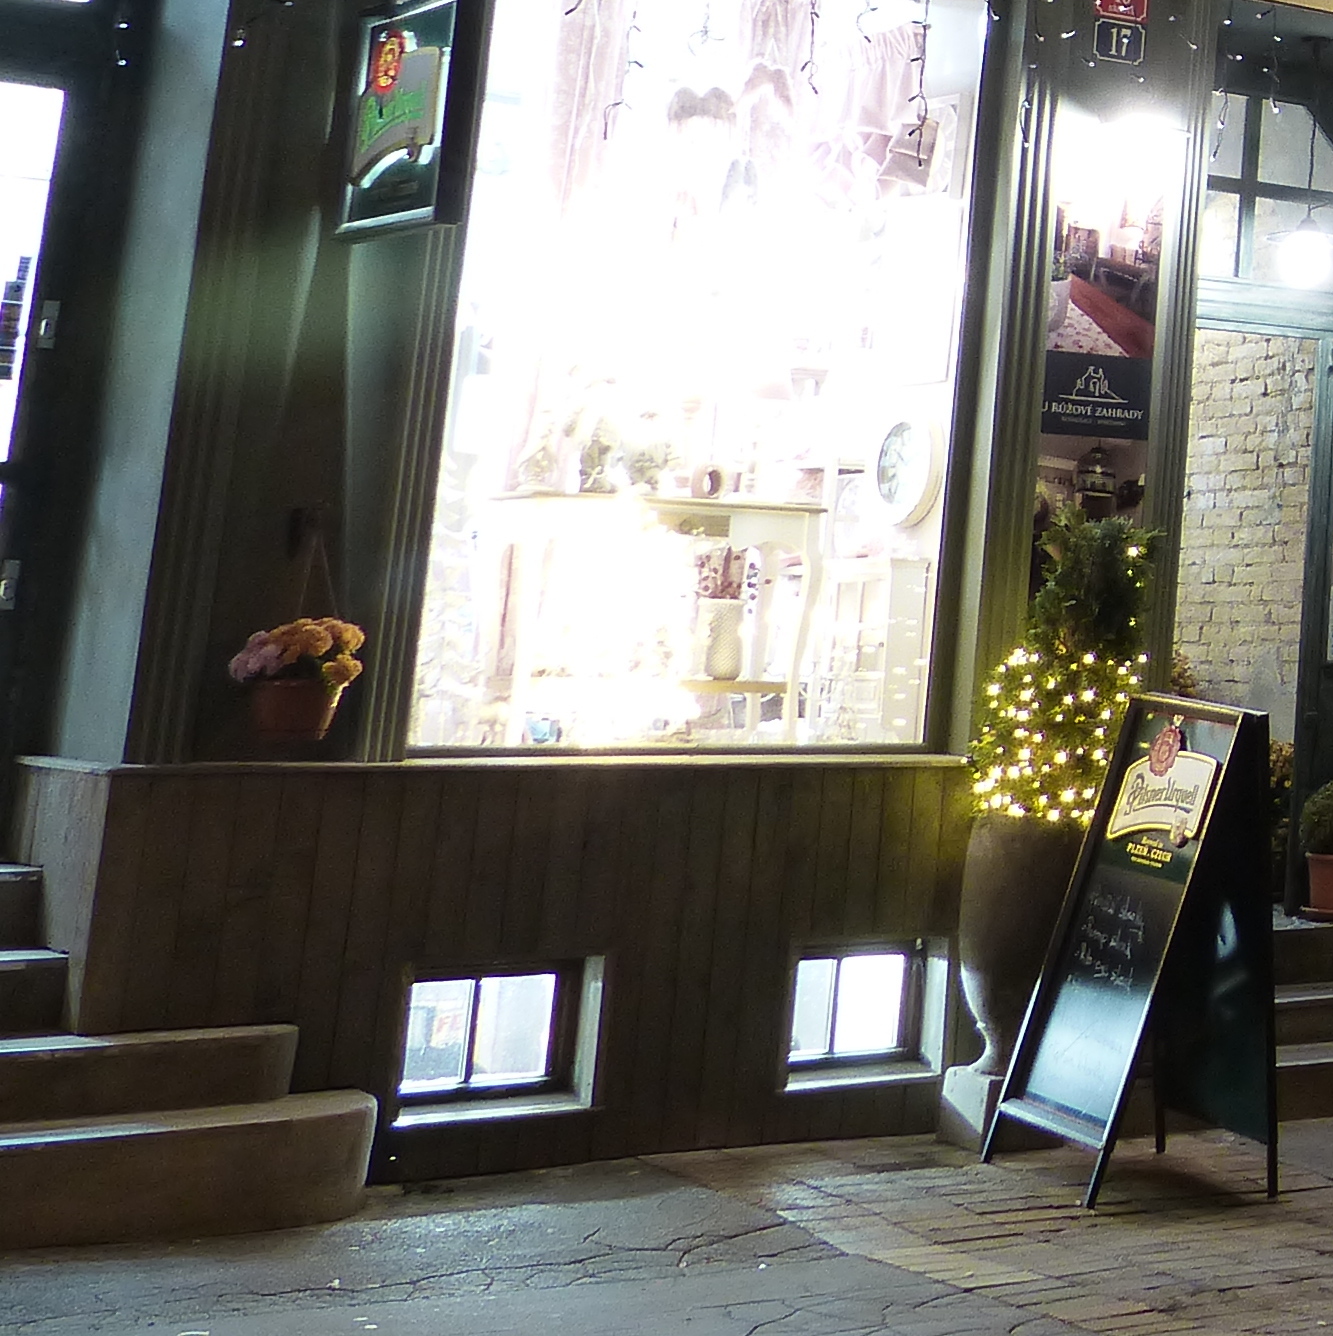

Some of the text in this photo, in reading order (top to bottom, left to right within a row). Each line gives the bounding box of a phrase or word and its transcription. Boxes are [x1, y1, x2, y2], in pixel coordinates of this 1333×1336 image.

[1109, 27, 1132, 58] 17
[1095, 407, 1144, 420] ZAHRADY
[1123, 772, 1201, 817] Pilsner Urquell
